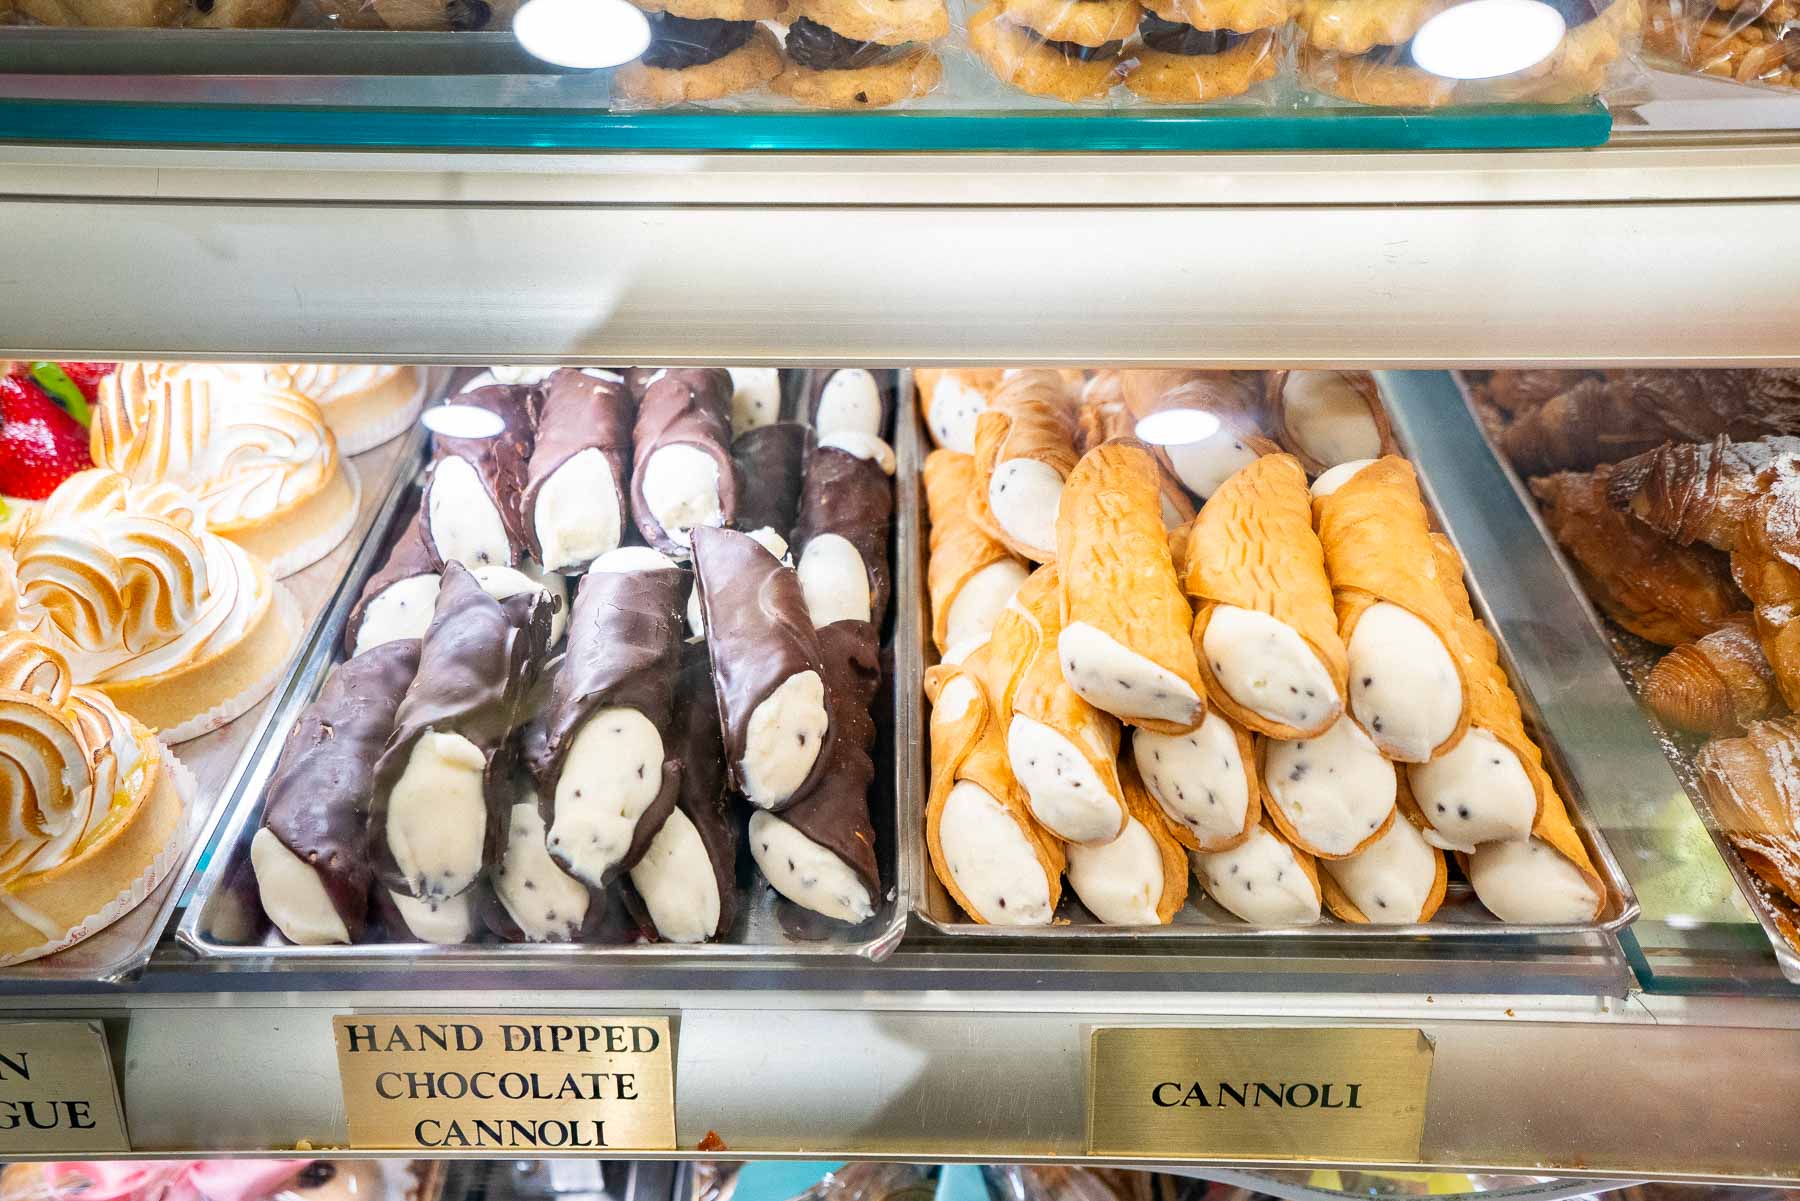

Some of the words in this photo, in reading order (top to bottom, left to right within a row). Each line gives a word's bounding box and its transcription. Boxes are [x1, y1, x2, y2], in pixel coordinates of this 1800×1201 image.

[343, 1024, 483, 1053] HAND
[499, 1025, 660, 1053] DIPPED
[375, 1071, 639, 1100] CHOCOLATE
[1151, 1081, 1362, 1109] CANNOLI
[0, 1101, 97, 1130] GUE
[414, 1119, 609, 1147] CANNOLI
